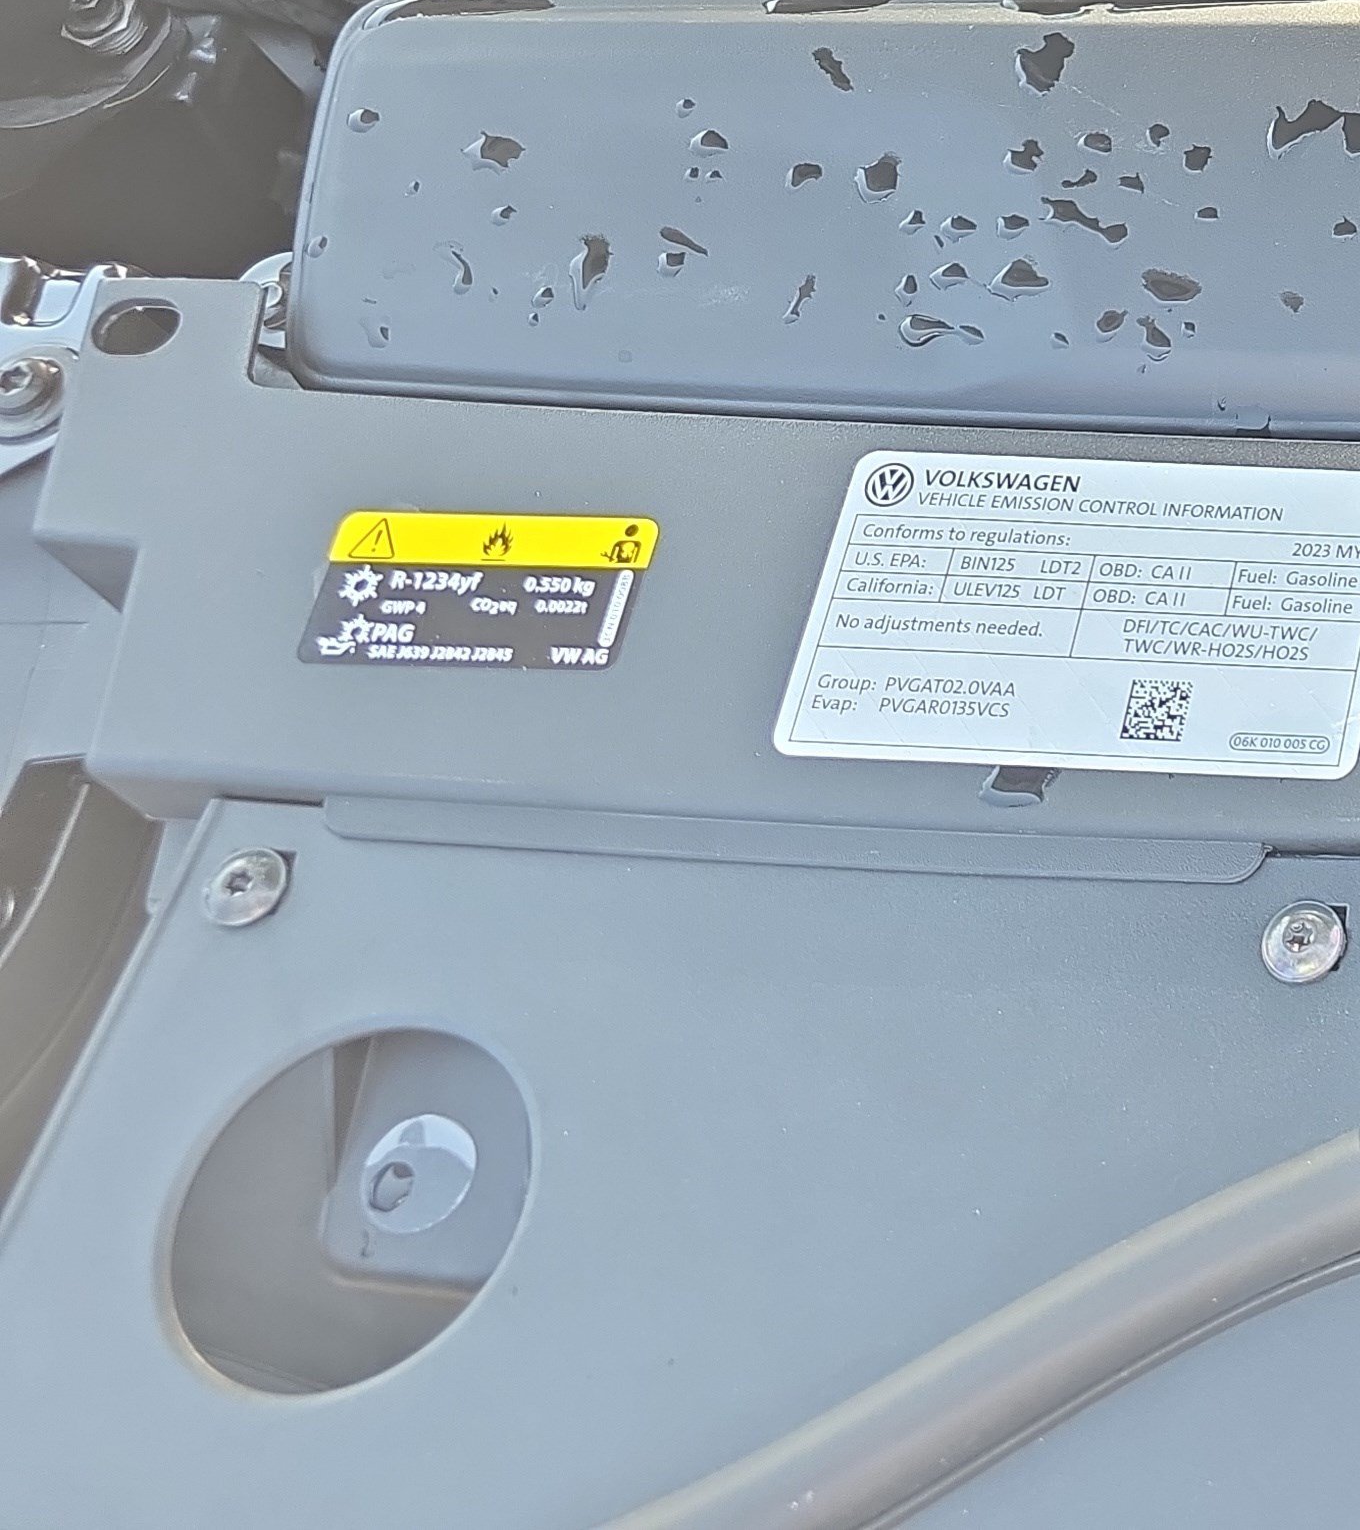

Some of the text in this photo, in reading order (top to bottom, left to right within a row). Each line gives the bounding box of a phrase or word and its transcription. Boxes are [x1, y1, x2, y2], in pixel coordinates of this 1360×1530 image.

[925, 469, 1081, 493] VOLKSWAGEN
[919, 491, 1284, 522] VEHICLE EMISSION CONTROL INFORMATION
[862, 523, 1071, 547] Conforms to regulations:
[854, 551, 927, 569] U.S. EPA:
[1291, 542, 1332, 558] 2023
[960, 555, 1017, 572] BIN125
[1040, 559, 1082, 575] LDT2
[1099, 562, 1143, 578] OBD:
[1151, 564, 1174, 580] CA
[388, 570, 484, 596] R-1234yf
[522, 576, 596, 597] 0.550 kg
[846, 577, 934, 596] California:
[1237, 568, 1358, 588] Fuel: Gasoline
[953, 581, 1067, 601] ULEV125 LDT
[1092, 588, 1136, 605] OBD:
[1145, 590, 1168, 606] CA
[1232, 595, 1353, 615] Fuel: Gasoline
[370, 622, 416, 643] PAG
[835, 613, 1043, 638] No adjustments needed.
[1122, 618, 1319, 642] DFI/TC/CAC/WU-TWC/
[1123, 638, 1310, 661] TWC/WR-HO2S/HO2S
[817, 673, 1015, 698] Group: PVGAT02.0VAA
[811, 694, 1010, 718] Evap: PVGAR0135VCS
